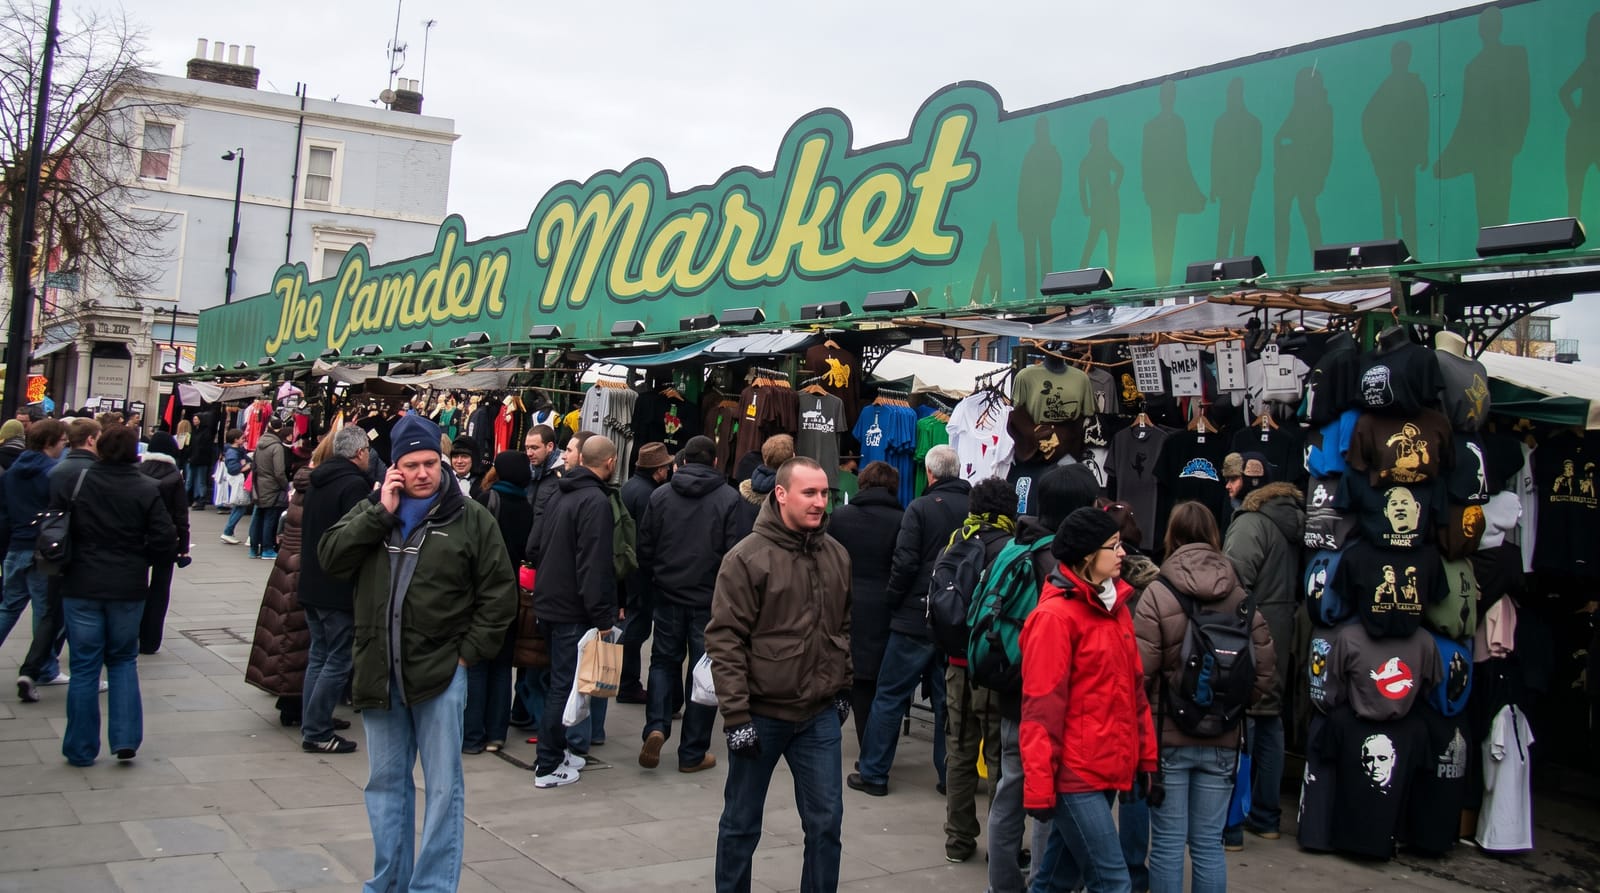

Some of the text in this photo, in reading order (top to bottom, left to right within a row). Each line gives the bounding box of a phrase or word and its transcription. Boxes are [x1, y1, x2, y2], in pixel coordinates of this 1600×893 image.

[264, 112, 974, 355] The Camden Market
